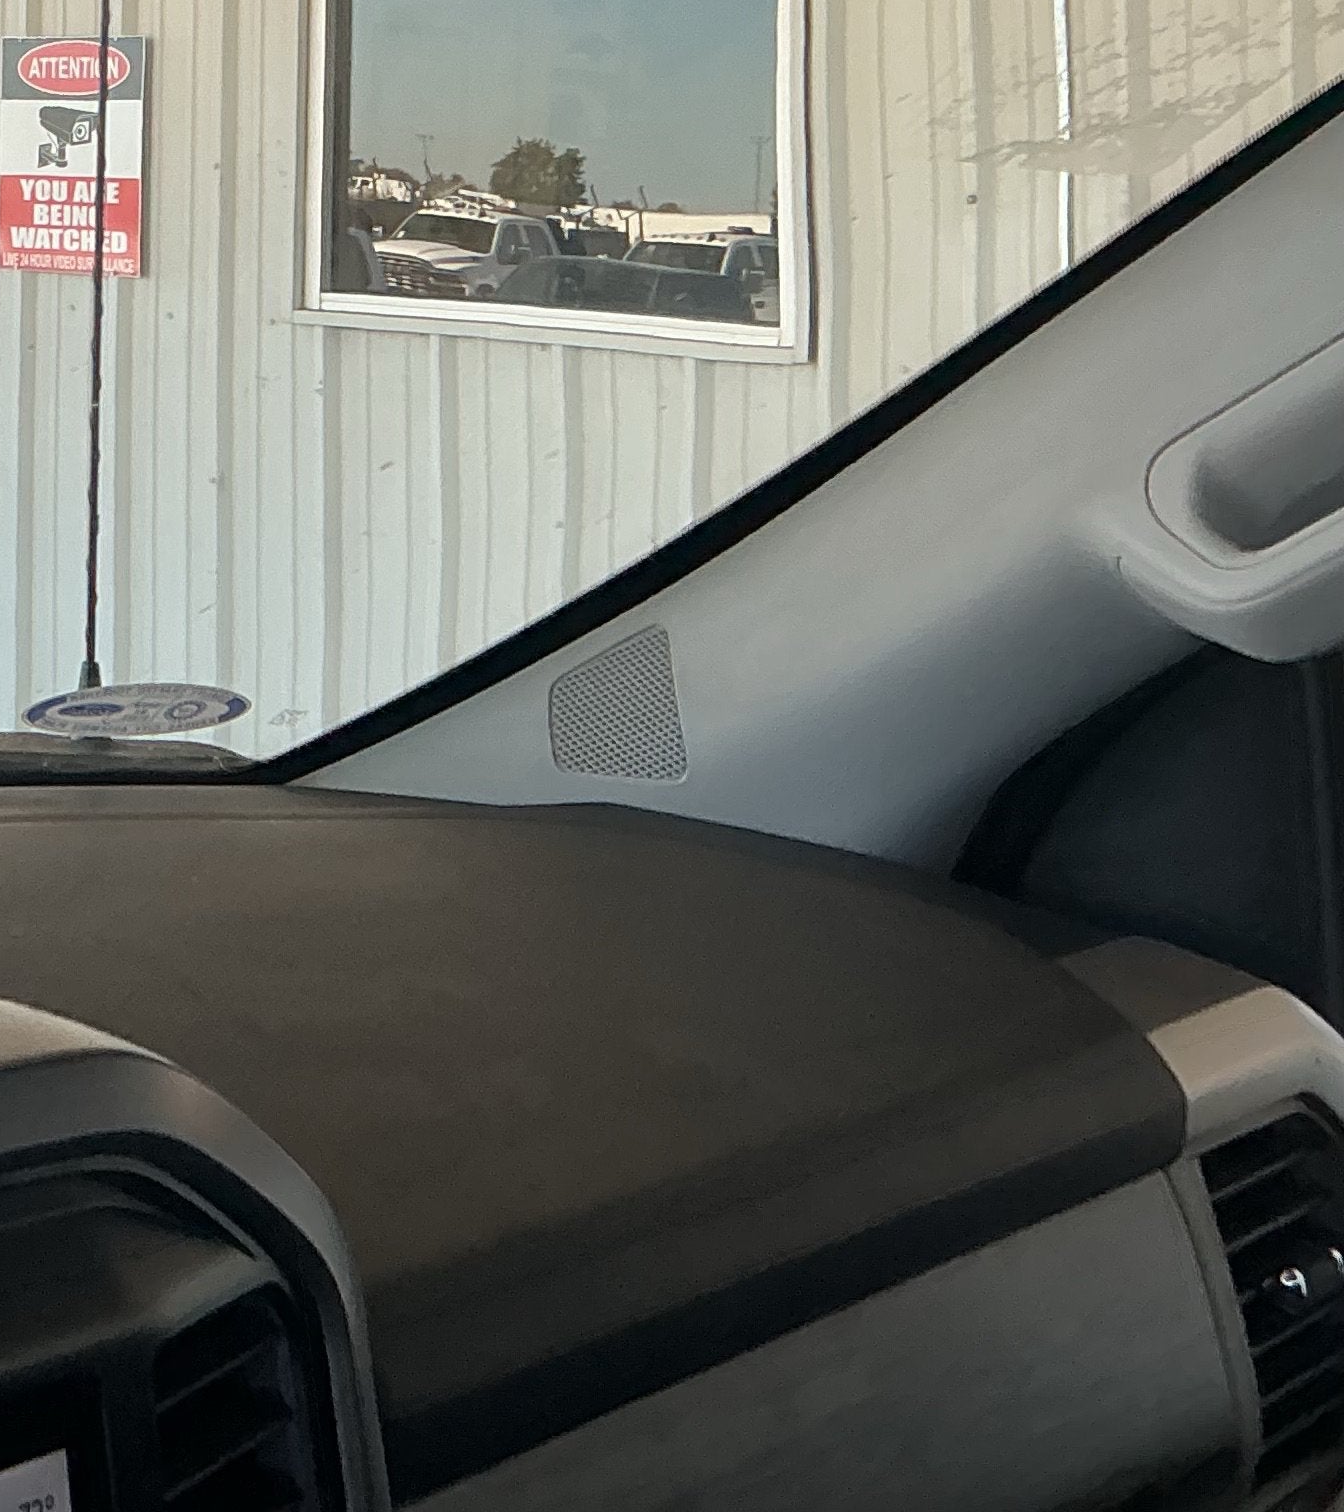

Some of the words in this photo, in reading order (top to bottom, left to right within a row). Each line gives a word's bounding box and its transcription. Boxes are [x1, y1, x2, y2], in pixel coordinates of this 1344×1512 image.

[20, 178, 68, 202] YOU
[3, 252, 20, 266] LIVE
[30, 254, 52, 268] HOUR
[53, 254, 76, 269] VIDEO
